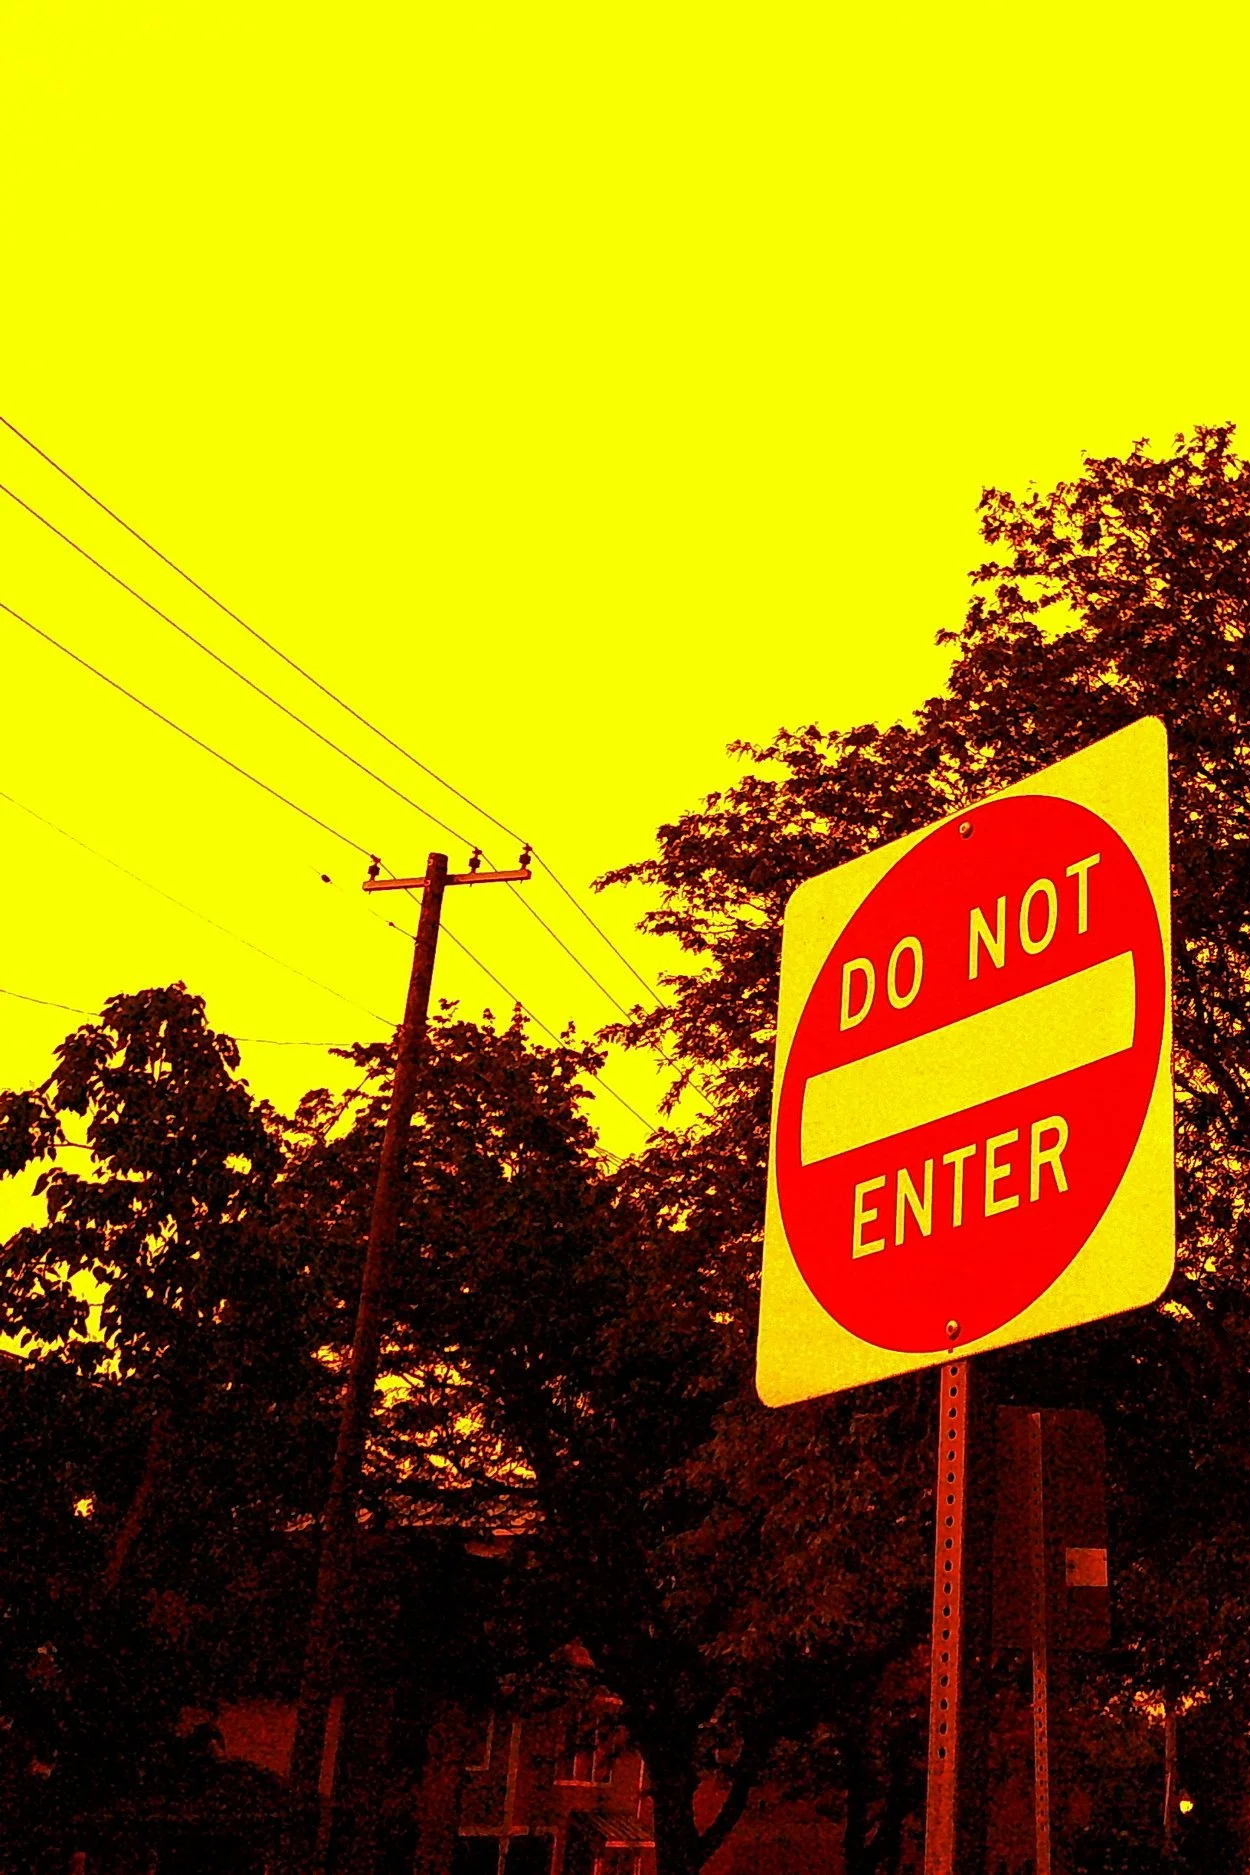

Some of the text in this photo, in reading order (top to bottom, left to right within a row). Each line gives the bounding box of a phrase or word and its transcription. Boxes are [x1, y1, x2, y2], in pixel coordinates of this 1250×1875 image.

[839, 853, 1100, 1032] DO NOT
[852, 1115, 1069, 1260] ENTER
